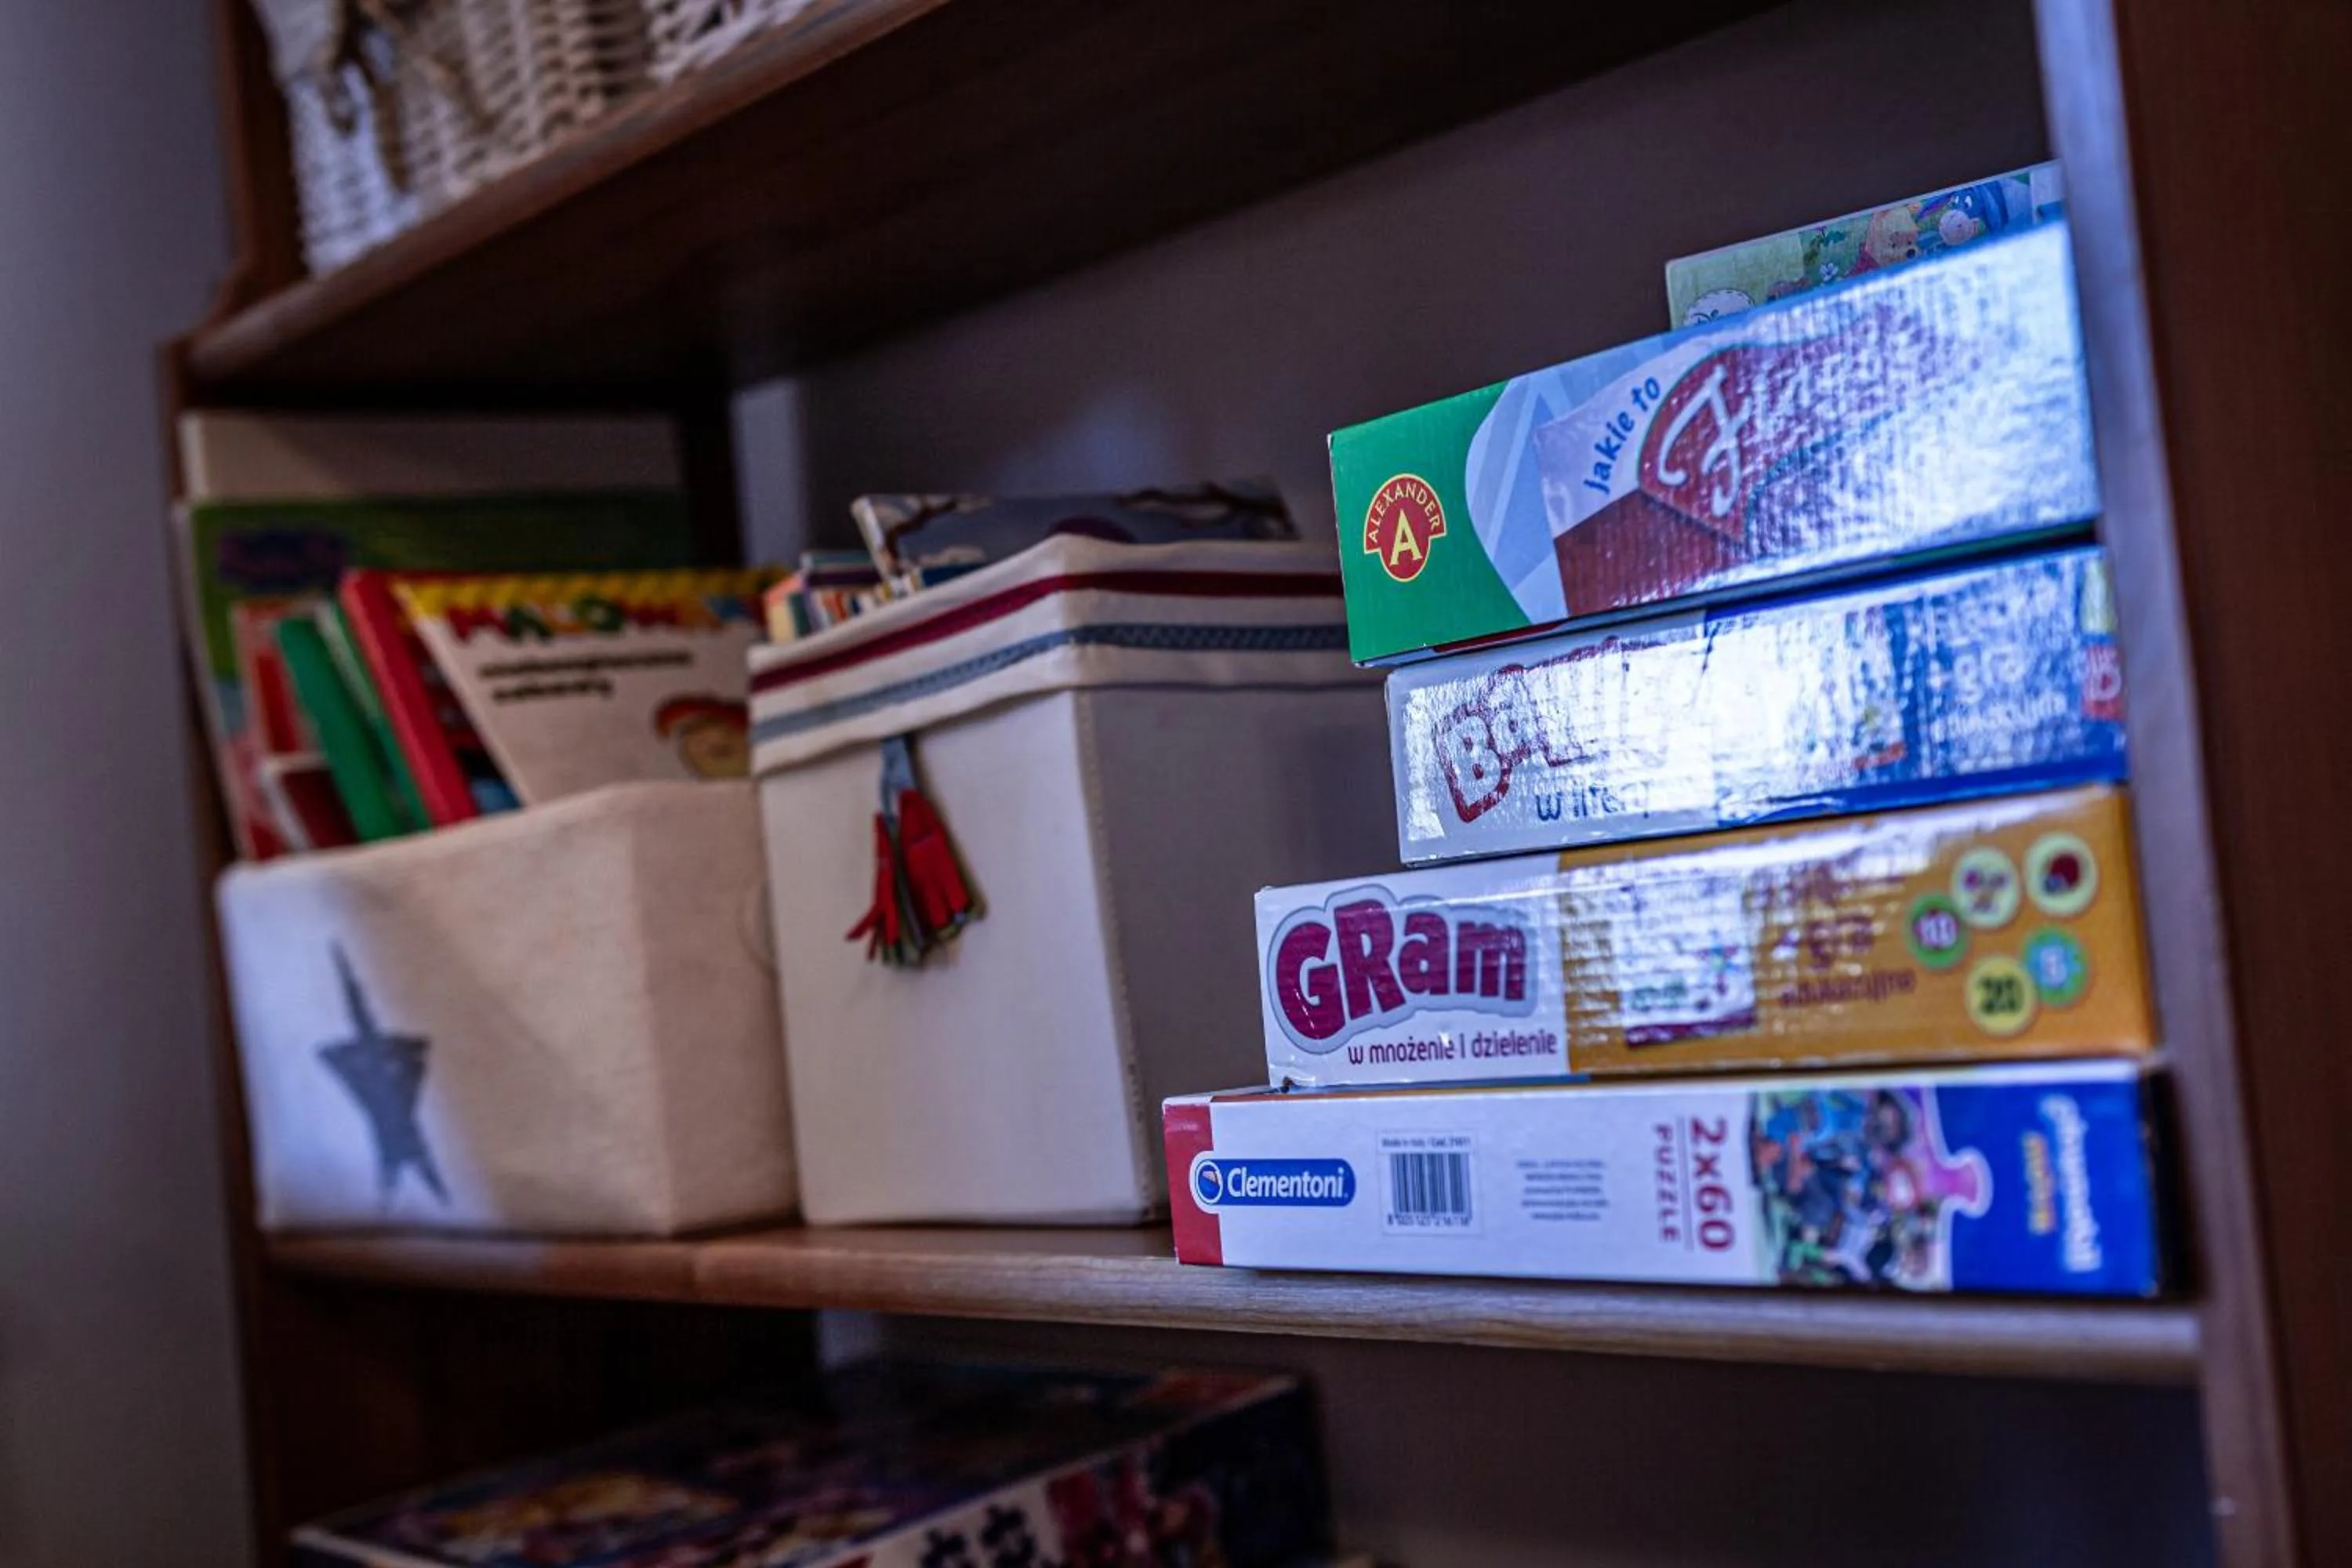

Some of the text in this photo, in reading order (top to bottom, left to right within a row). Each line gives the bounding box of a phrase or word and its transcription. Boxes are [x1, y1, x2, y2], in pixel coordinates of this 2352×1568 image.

[1583, 376, 1661, 495] Jakie to
[1367, 481, 1441, 544] ALEXANDER
[1388, 508, 1423, 566] A
[1276, 898, 1527, 1040] GRam
[1348, 1045, 1363, 1065] w
[1369, 1035, 1456, 1064] mnożenie
[1471, 1028, 1558, 1058] dzielenie
[1227, 1166, 1345, 1198] Clementoni
[1653, 1123, 1682, 1243] PUZZLE
[1690, 1113, 1736, 1252] 2x60
